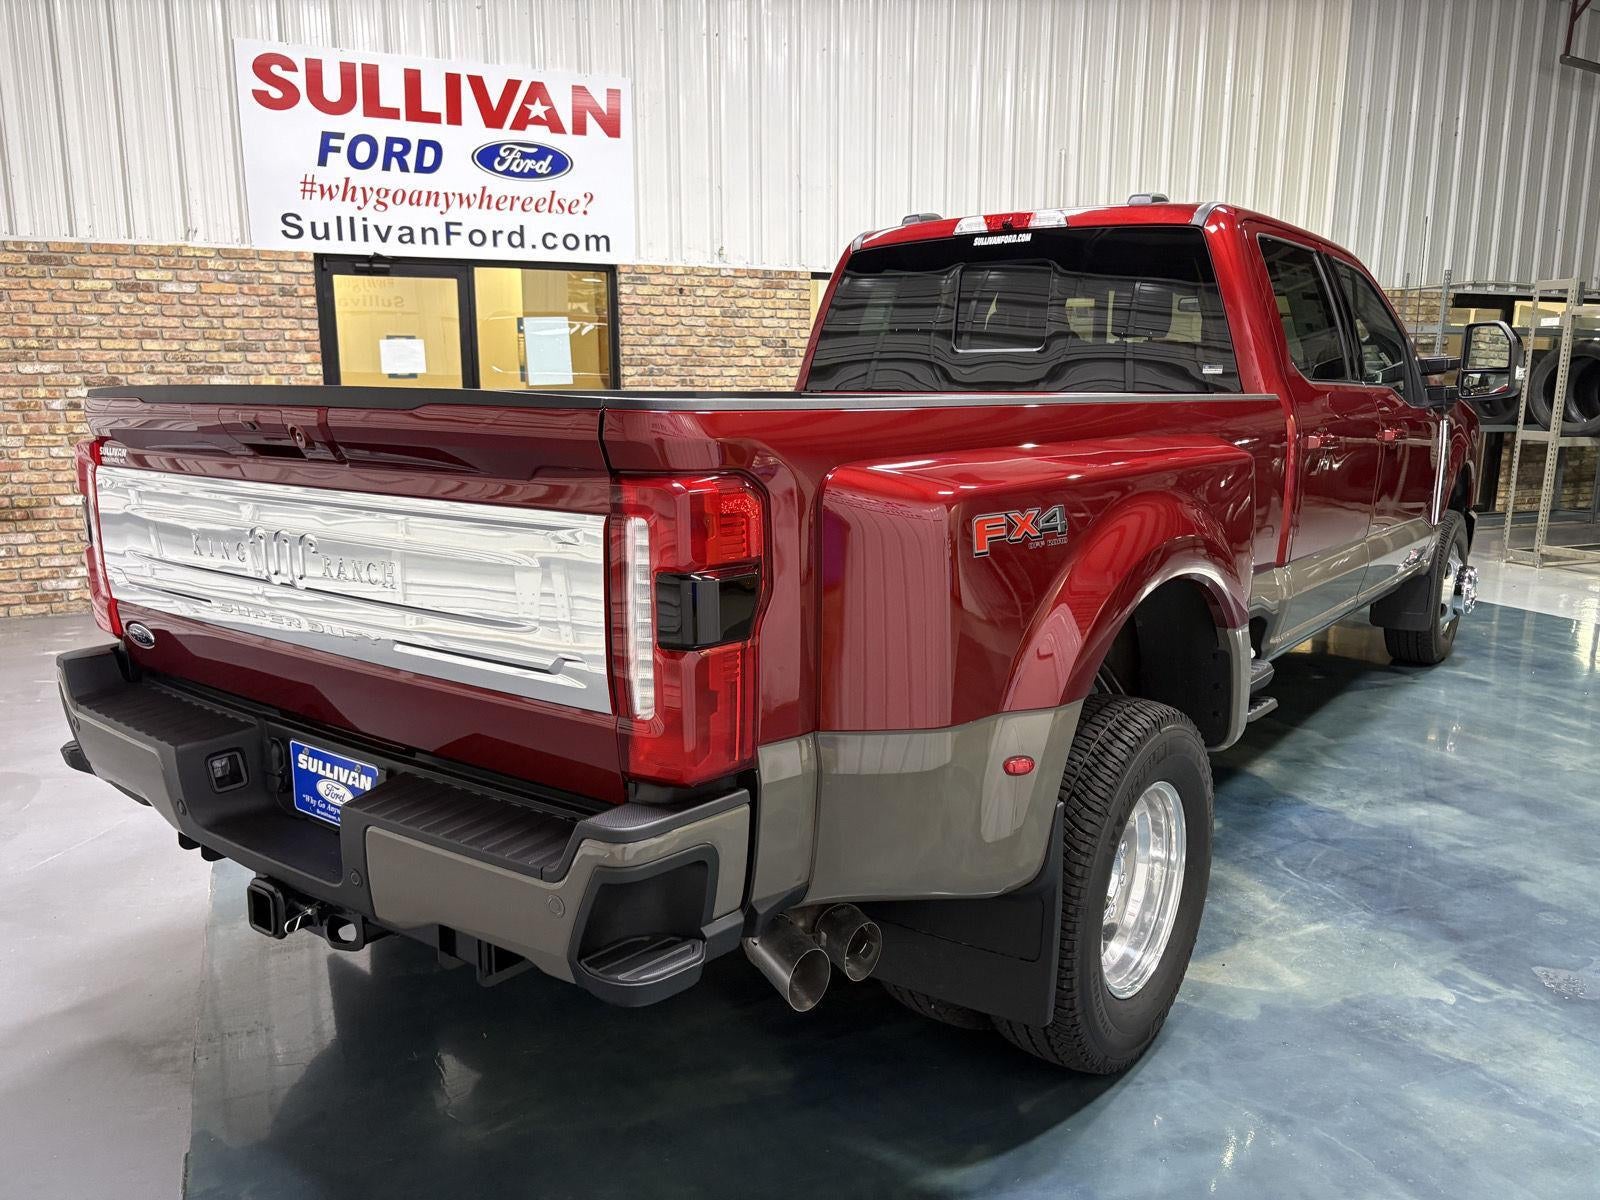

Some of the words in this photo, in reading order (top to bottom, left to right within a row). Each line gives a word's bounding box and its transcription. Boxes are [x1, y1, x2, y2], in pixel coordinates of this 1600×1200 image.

[251, 52, 622, 138] SULLIVAN
[316, 130, 443, 174] FORD
[494, 144, 552, 175] Ford
[299, 173, 594, 217] #whygoanywhereelse?
[280, 212, 611, 253] SullivanFord.com
[972, 232, 1033, 247] SULLIVANFORD.COM
[99, 446, 127, 457] SULLIVAN
[972, 504, 1068, 558] FX4
[190, 531, 248, 562] KING
[320, 554, 398, 590] RANCH
[297, 753, 372, 791] SULLIVAN
[324, 783, 346, 803] Ford
